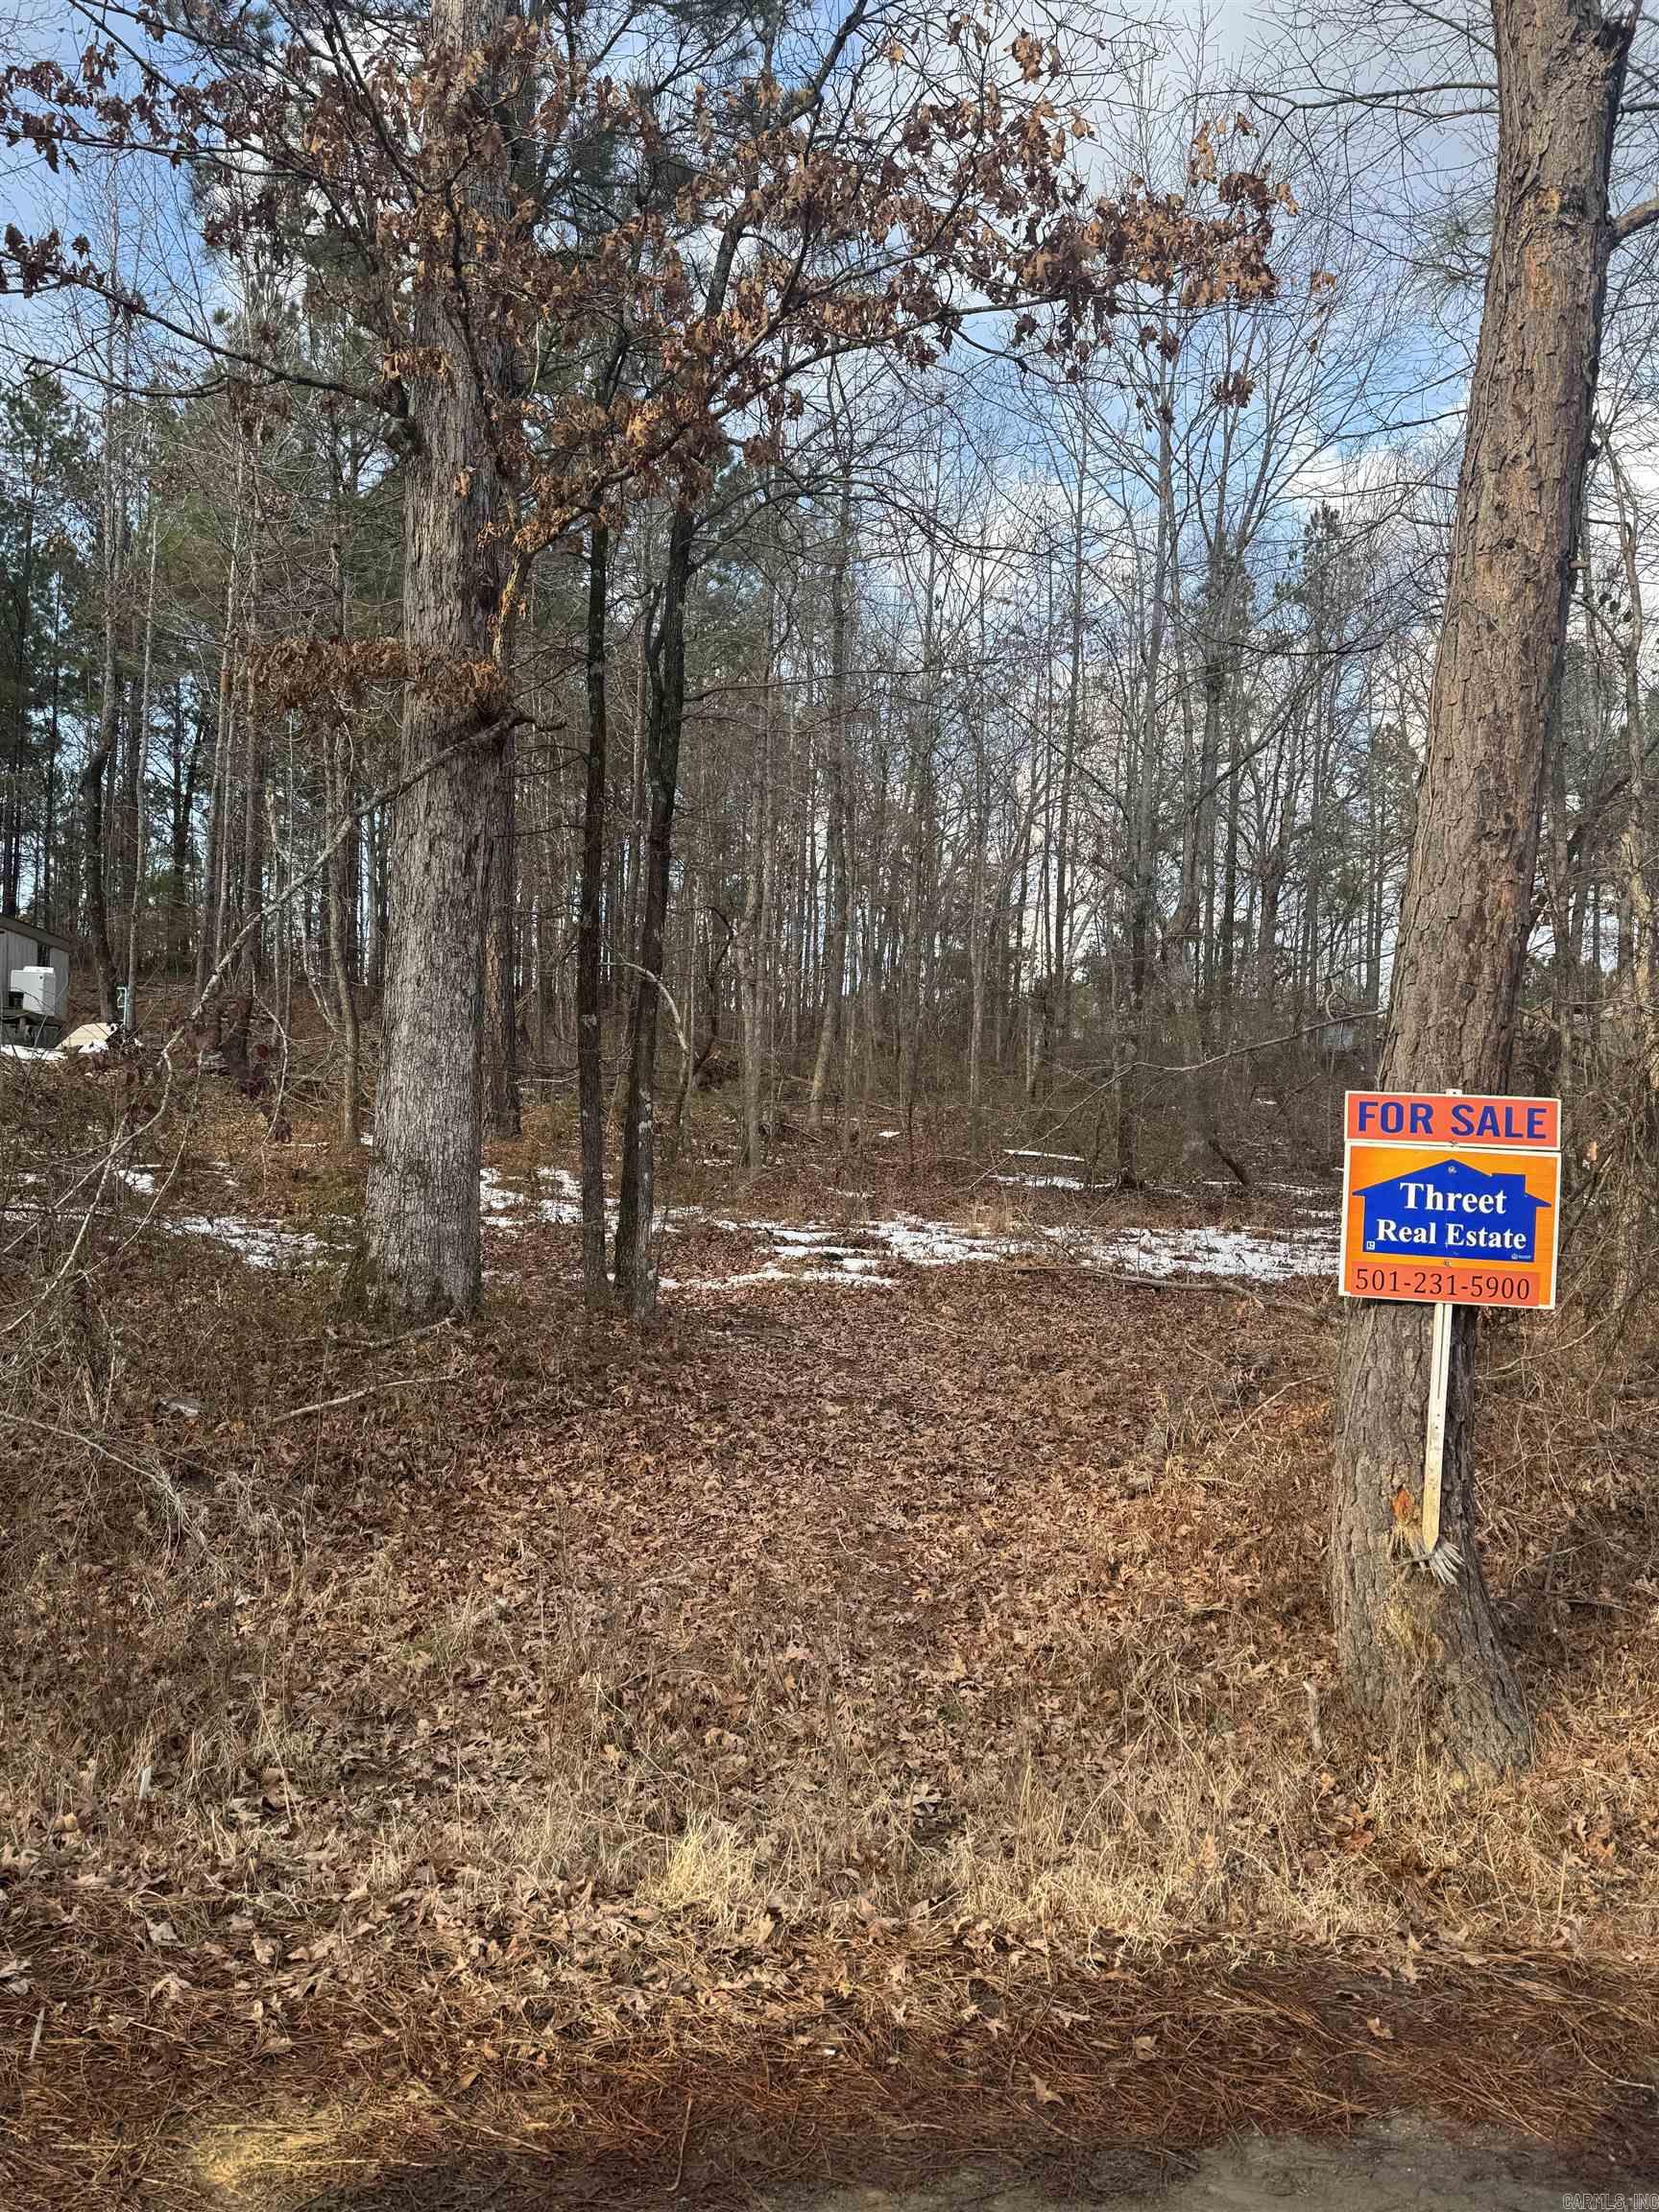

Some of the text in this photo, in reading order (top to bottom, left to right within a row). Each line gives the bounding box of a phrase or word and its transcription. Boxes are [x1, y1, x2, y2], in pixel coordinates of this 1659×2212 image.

[1358, 1101, 1548, 1140] FOR SALE
[1400, 1182, 1507, 1214] Threet
[1377, 1218, 1527, 1250] Real Estate
[1356, 1268, 1530, 1300] 501-231-5900
